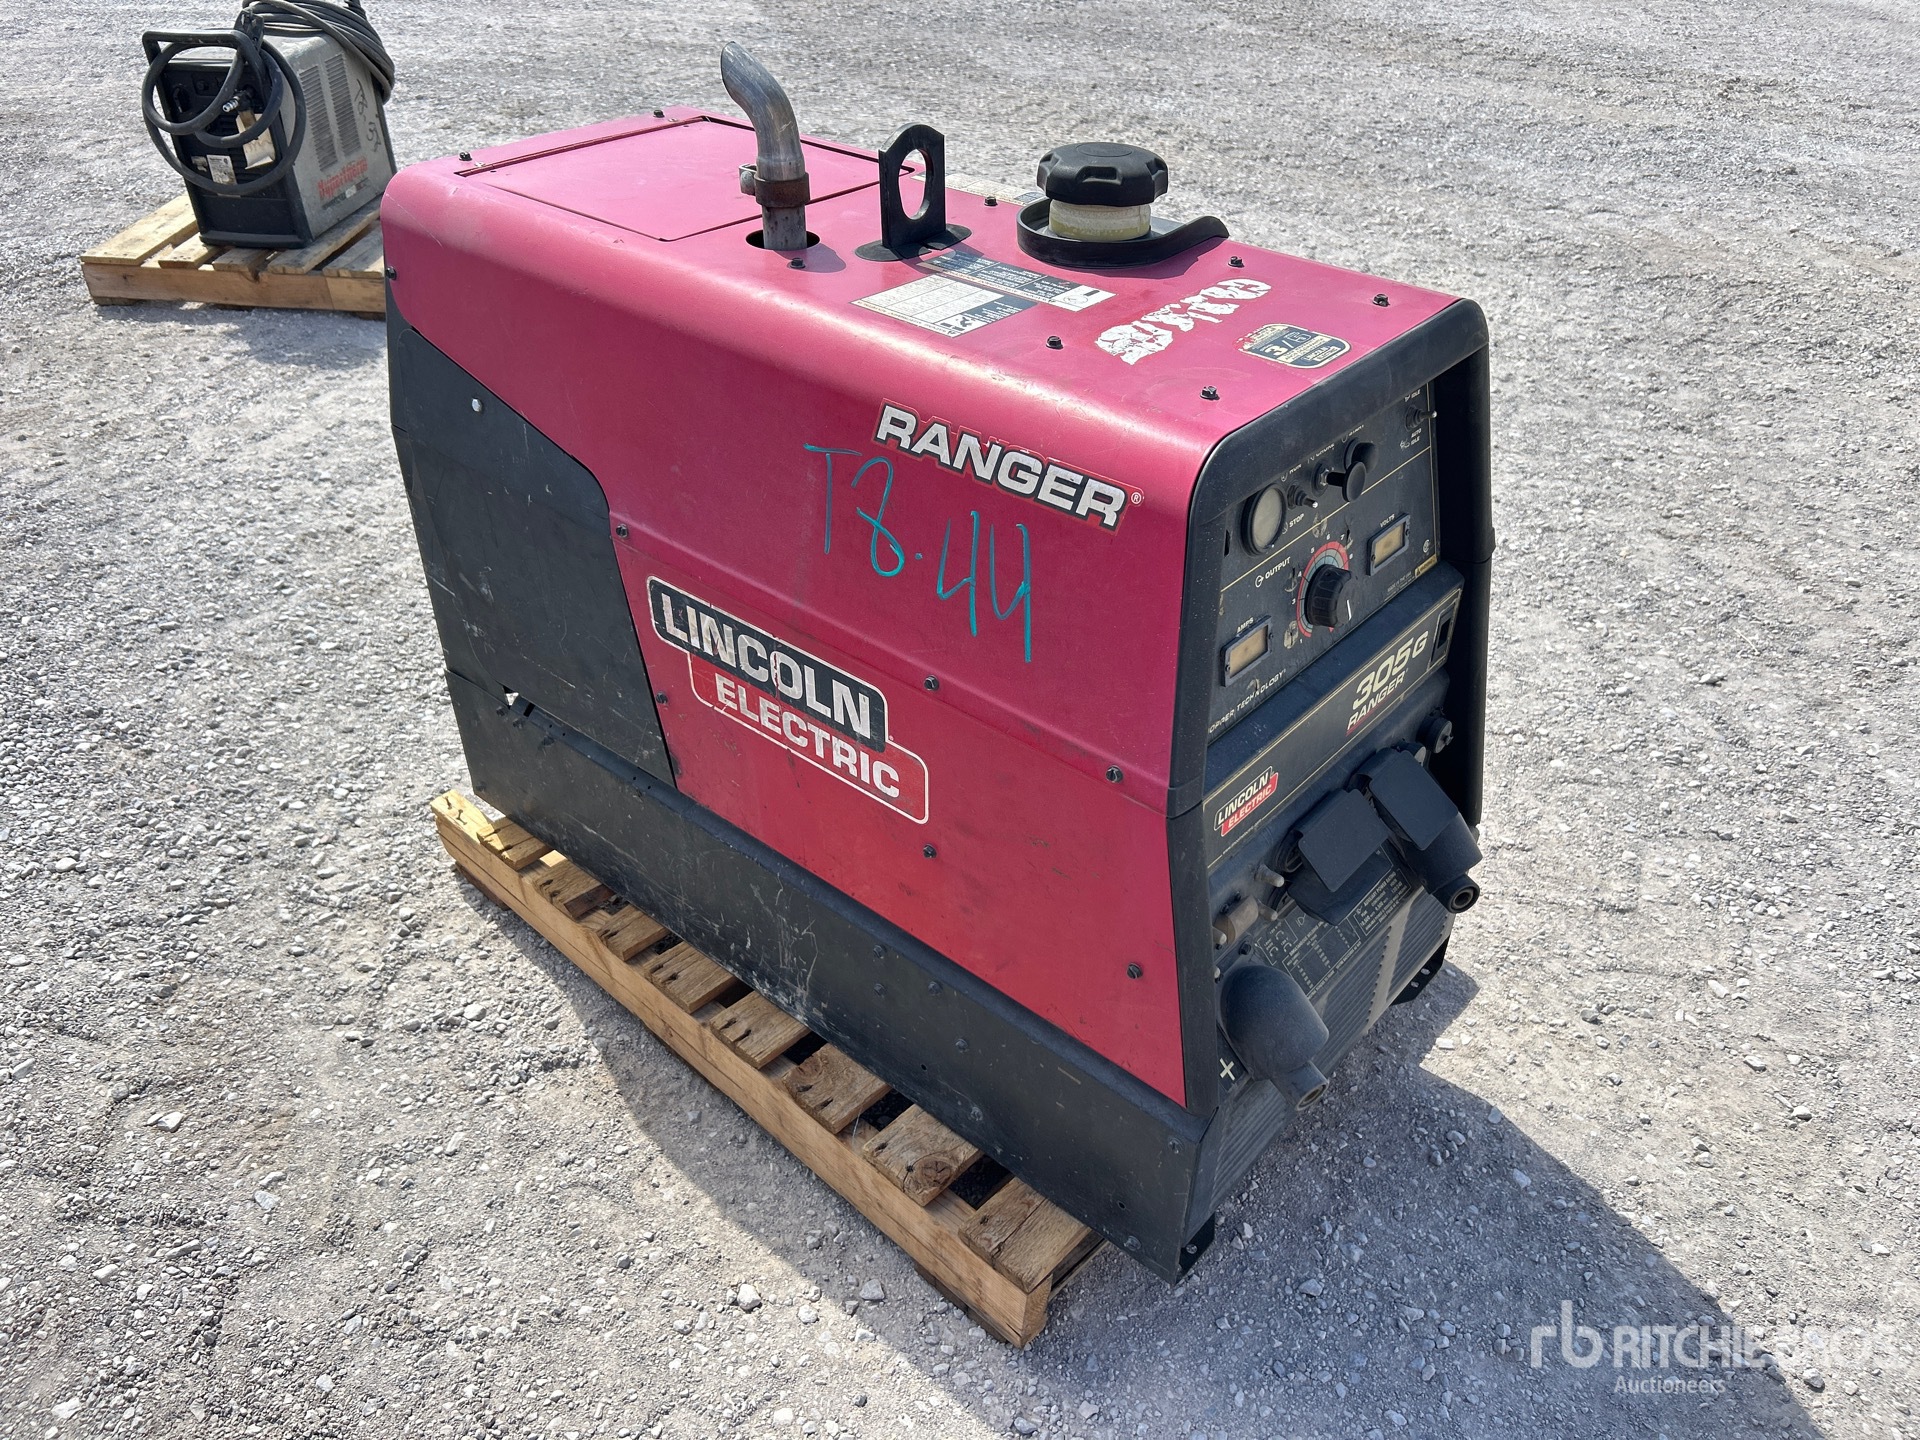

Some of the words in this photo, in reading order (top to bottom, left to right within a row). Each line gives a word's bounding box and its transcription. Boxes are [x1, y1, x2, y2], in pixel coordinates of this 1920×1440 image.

[1289, 513, 1305, 528] STOP
[1379, 513, 1395, 528] VOLTS
[1264, 556, 1291, 579] OUTPUT
[1236, 617, 1254, 633] AMPS
[661, 592, 871, 739] LINCOLN
[1353, 631, 1429, 710] 305G
[715, 672, 900, 798] ELECTRIC
[1217, 771, 1269, 825] LINCOLN
[1227, 784, 1272, 828] ELECTRIC
